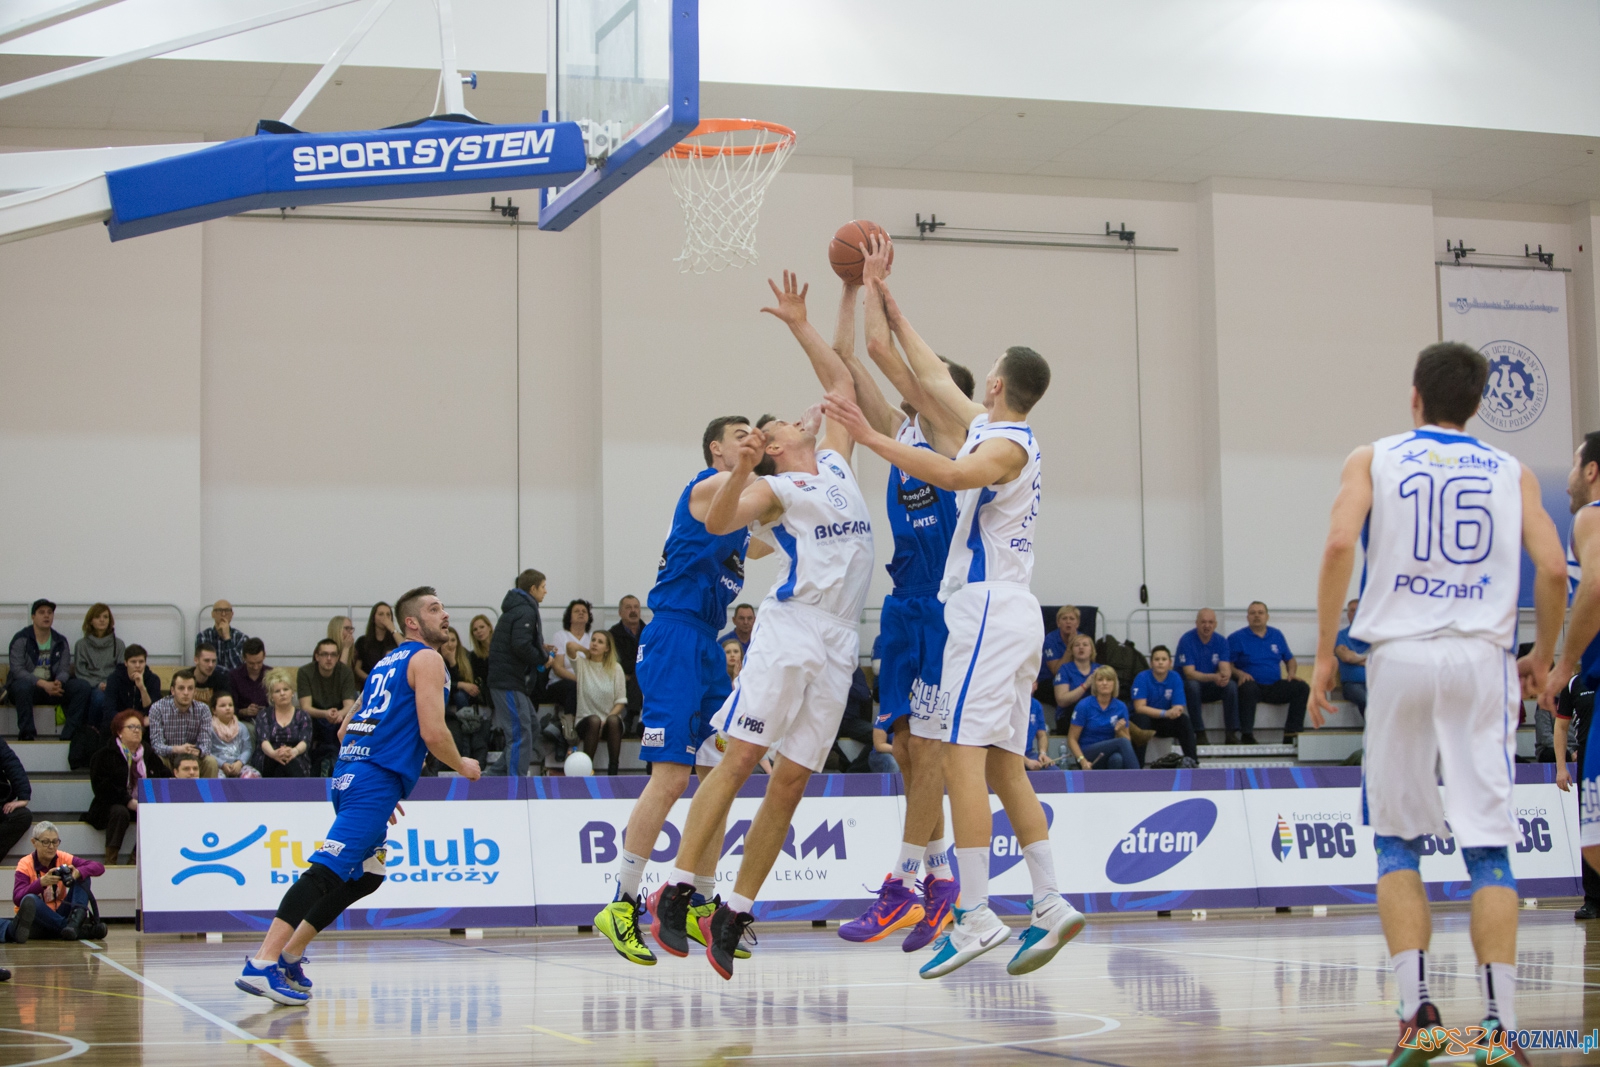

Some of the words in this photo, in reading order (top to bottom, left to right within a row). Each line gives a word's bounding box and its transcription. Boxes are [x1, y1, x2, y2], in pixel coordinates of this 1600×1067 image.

[826, 485, 848, 510] 5
[1400, 472, 1494, 565] 16
[358, 668, 396, 719] 25
[743, 717, 765, 734] PBG
[1292, 811, 1352, 822] fundacja
[264, 828, 500, 869] fuclub
[1120, 826, 1198, 854] atrem
[1295, 822, 1356, 860] PBG
[1515, 817, 1553, 853] BG
[775, 867, 828, 881] LEKÓW
